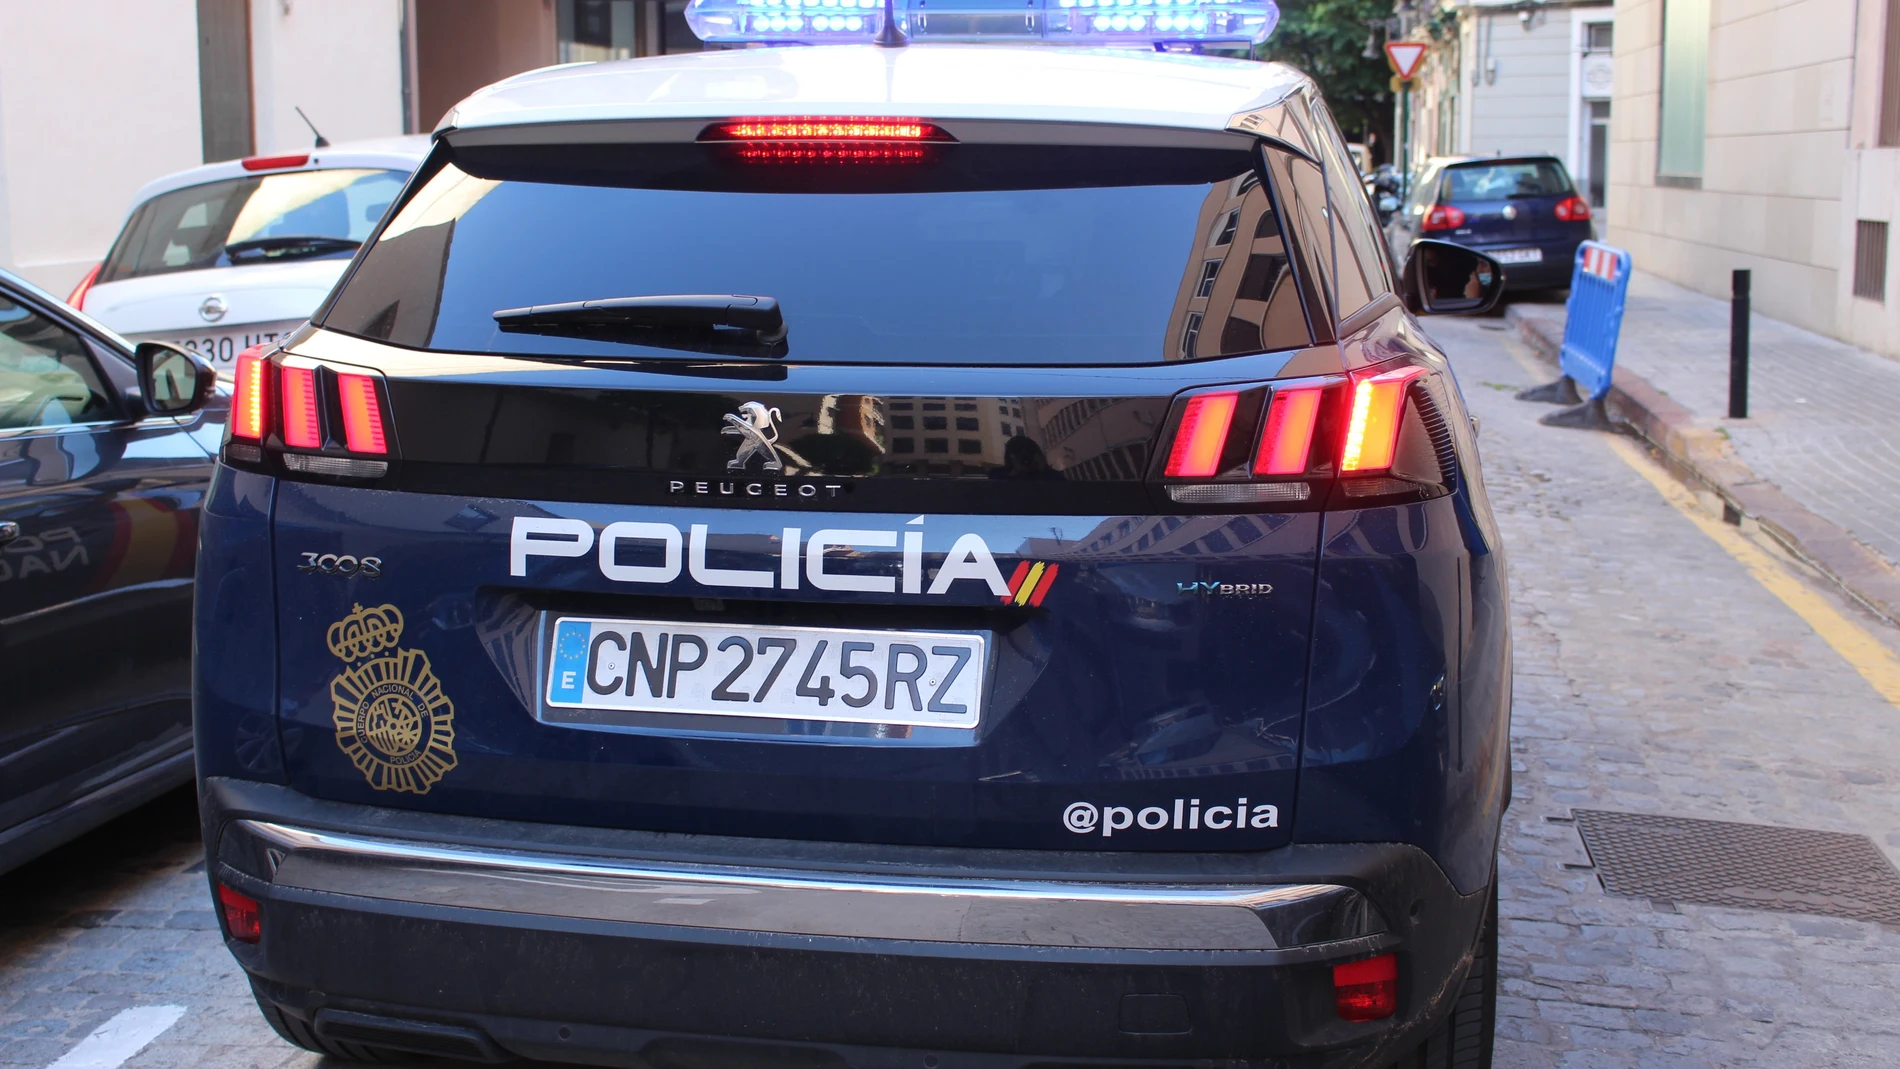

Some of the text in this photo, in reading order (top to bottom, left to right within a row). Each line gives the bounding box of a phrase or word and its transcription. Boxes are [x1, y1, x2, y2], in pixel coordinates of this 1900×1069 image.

[669, 480, 842, 498] PEUGEOT
[297, 552, 382, 578] 3008
[510, 514, 1013, 597] POLICÍA
[1176, 581, 1274, 596] HYBRID
[561, 670, 577, 690] E
[357, 701, 370, 744] CUERPO
[371, 684, 415, 700] NACIONAL
[417, 703, 429, 718] DE
[1062, 797, 1279, 837] @policia
